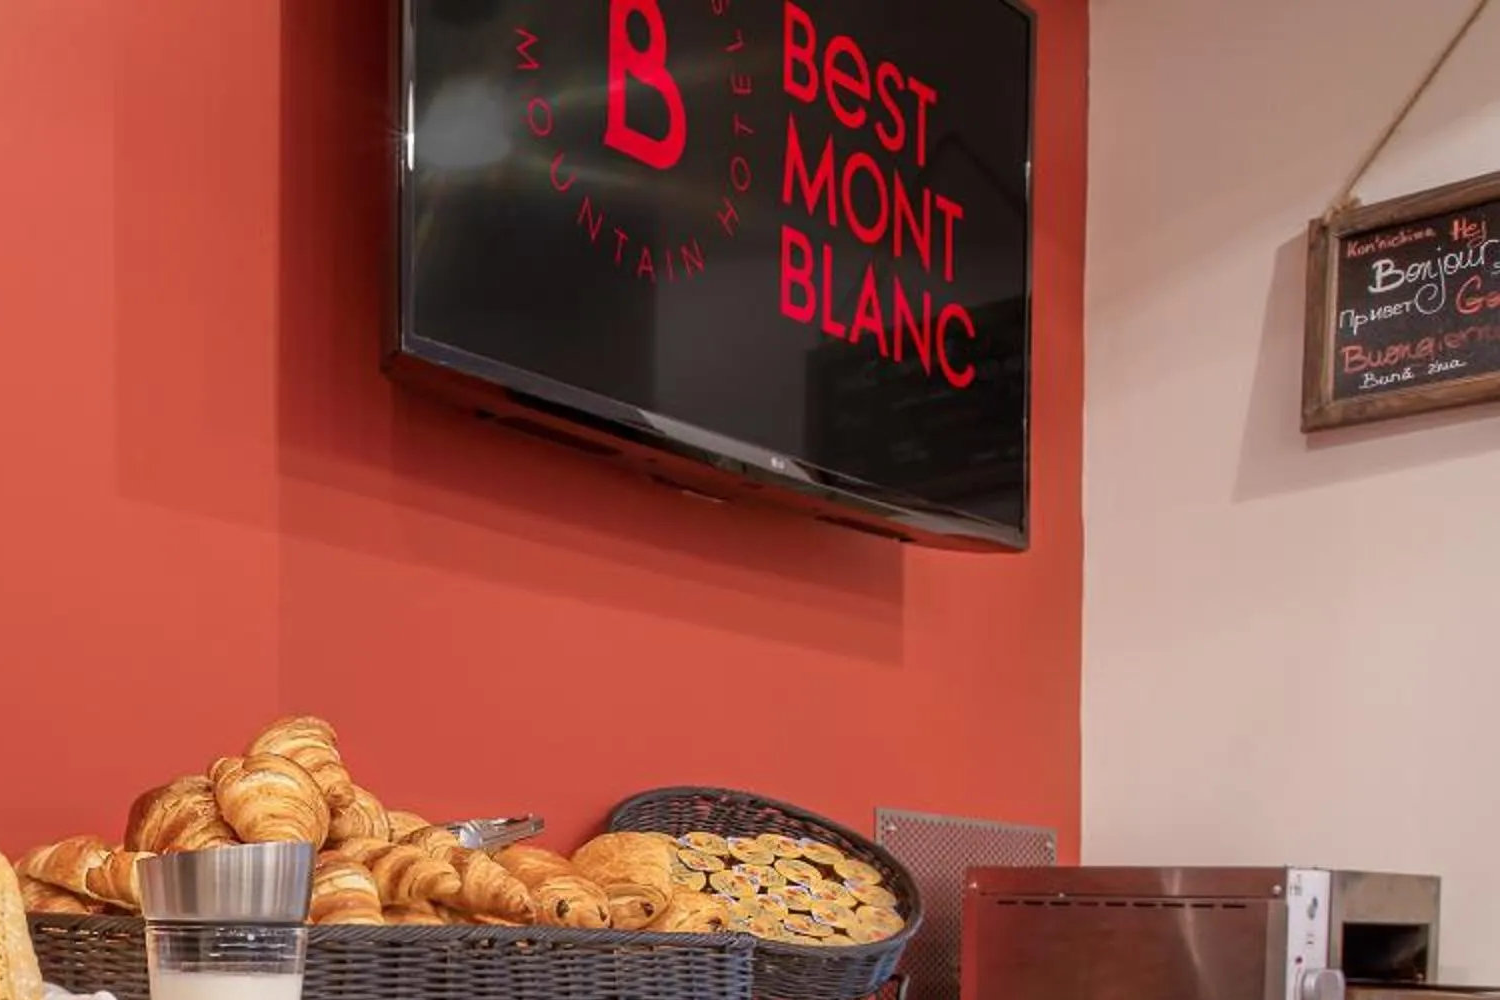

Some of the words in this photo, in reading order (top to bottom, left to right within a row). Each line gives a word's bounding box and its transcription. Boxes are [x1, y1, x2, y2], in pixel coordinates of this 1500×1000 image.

[514, 27, 705, 283] MOUNTAIN
[604, 0, 687, 170] B
[782, 110, 963, 283] MONT
[1367, 239, 1500, 315] Bonjour
[780, 222, 976, 388] BLANC
